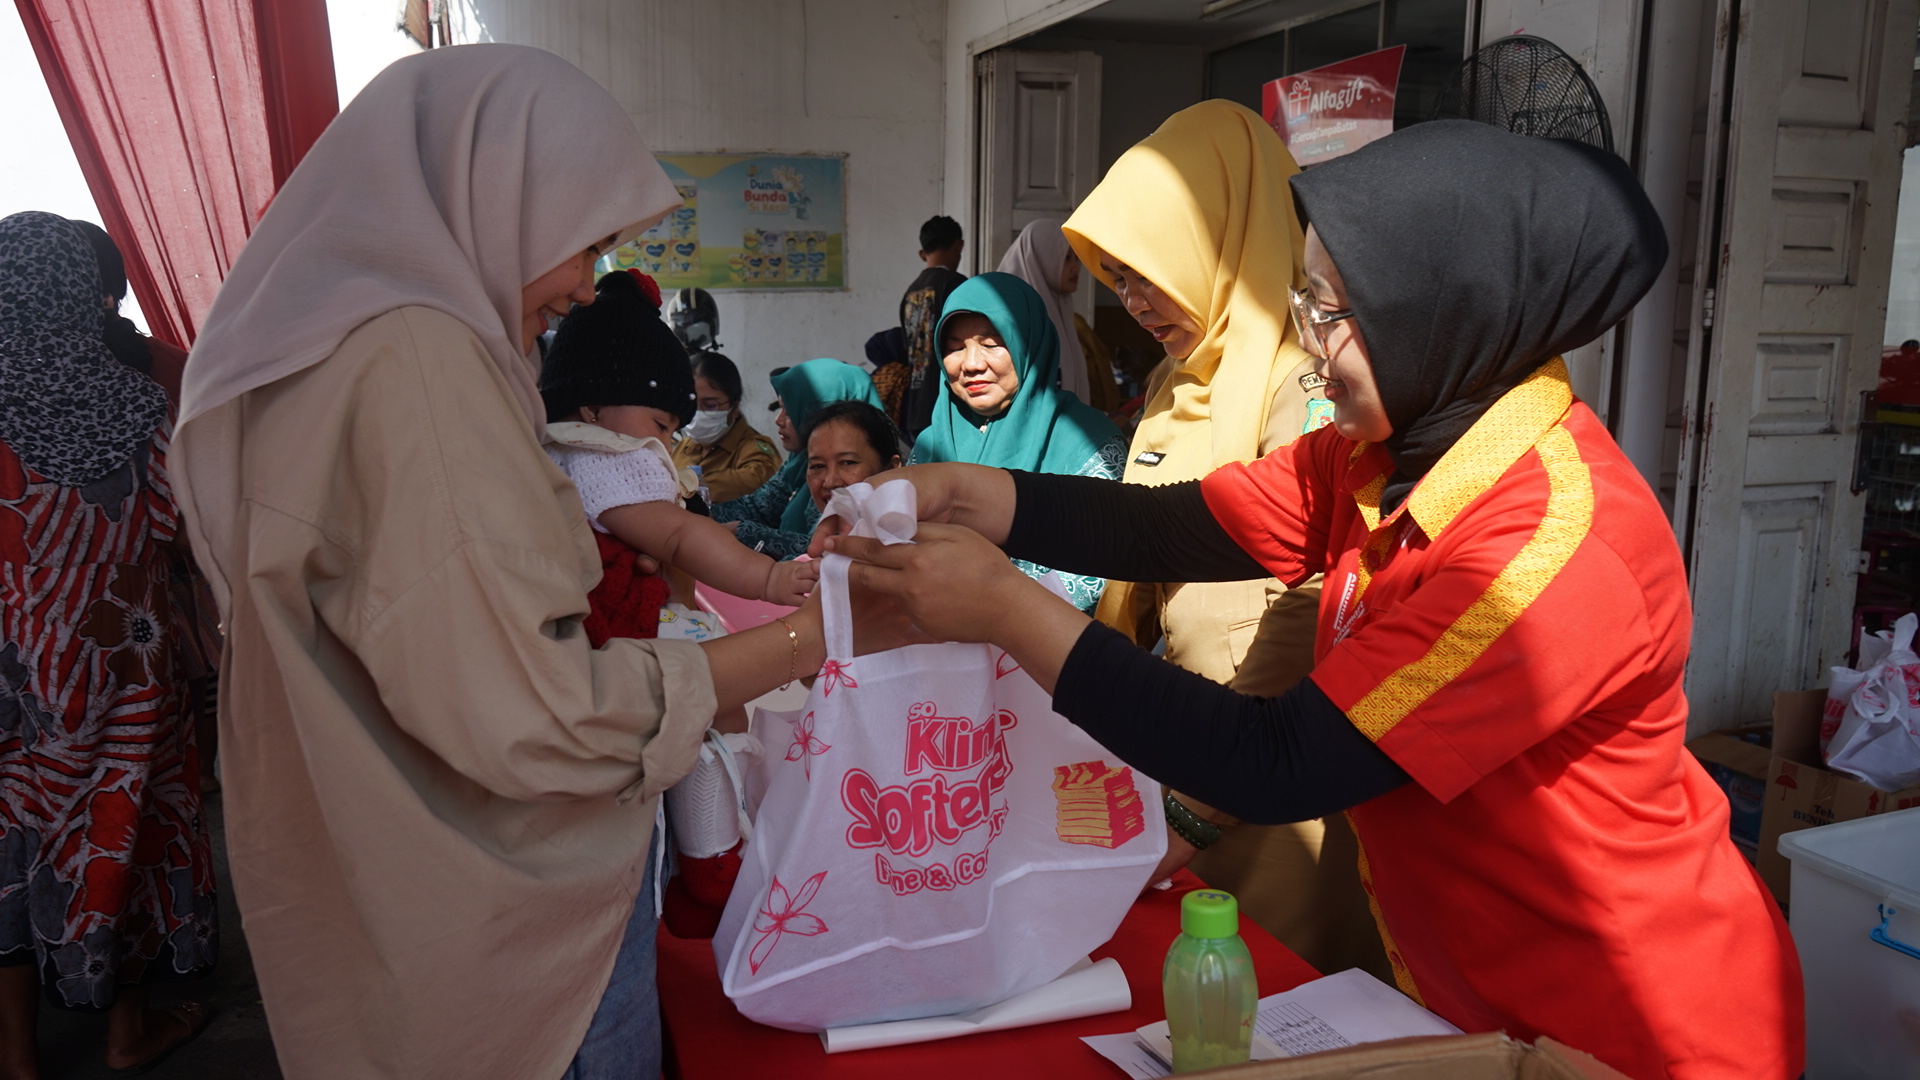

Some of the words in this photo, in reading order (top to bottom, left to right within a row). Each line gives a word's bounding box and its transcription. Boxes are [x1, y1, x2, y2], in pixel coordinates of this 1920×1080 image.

[1310, 78, 1364, 114] Alfagift
[750, 179, 783, 190] Dunia
[744, 189, 787, 202] Bunda
[749, 202, 759, 212] Si
[762, 202, 787, 212] Kecil
[1814, 804, 1835, 819] Teh
[875, 853, 924, 896] Fne
[923, 863, 956, 891] &
